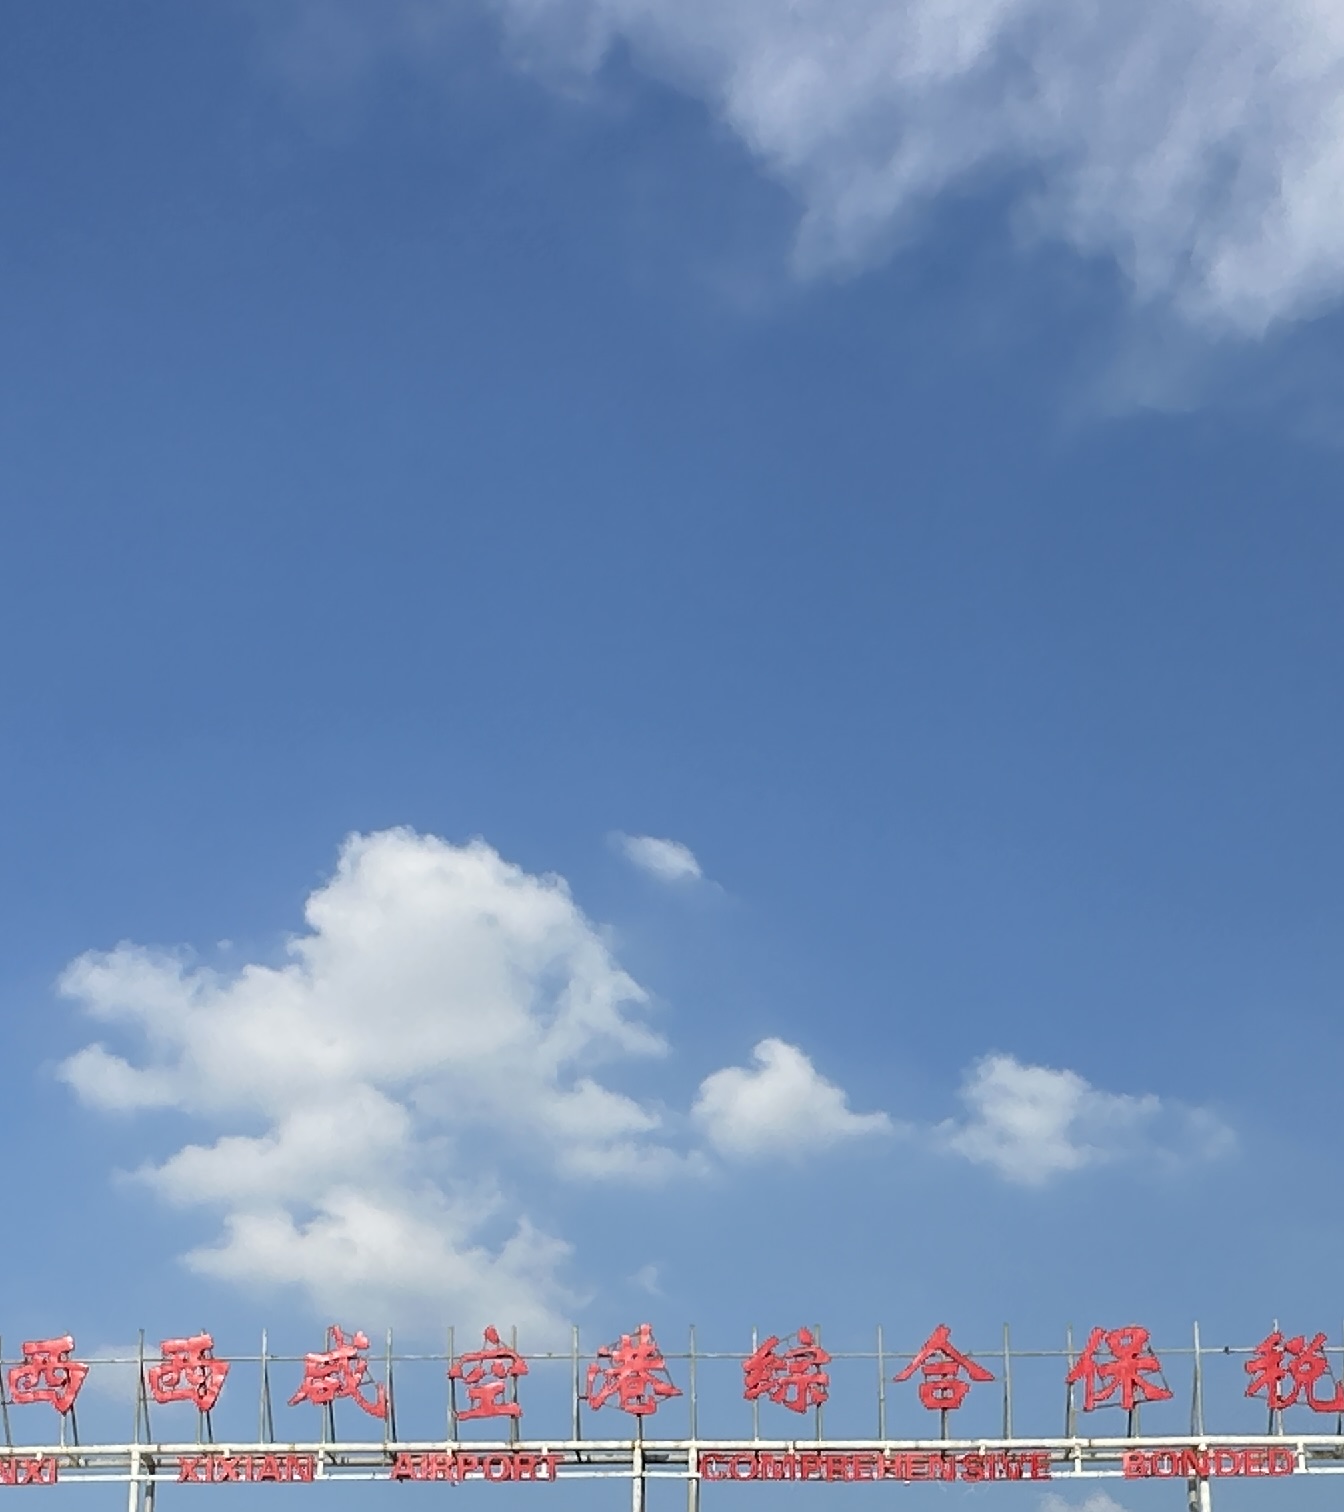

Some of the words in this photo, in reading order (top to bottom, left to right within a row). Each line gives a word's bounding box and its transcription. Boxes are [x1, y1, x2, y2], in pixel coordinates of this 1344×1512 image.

[177, 1454, 316, 1483] XIXIAN
[391, 1452, 564, 1482] AIRPORT
[697, 1451, 1052, 1482] COMPREHENSIVE
[1122, 1447, 1296, 1478] BONDED
